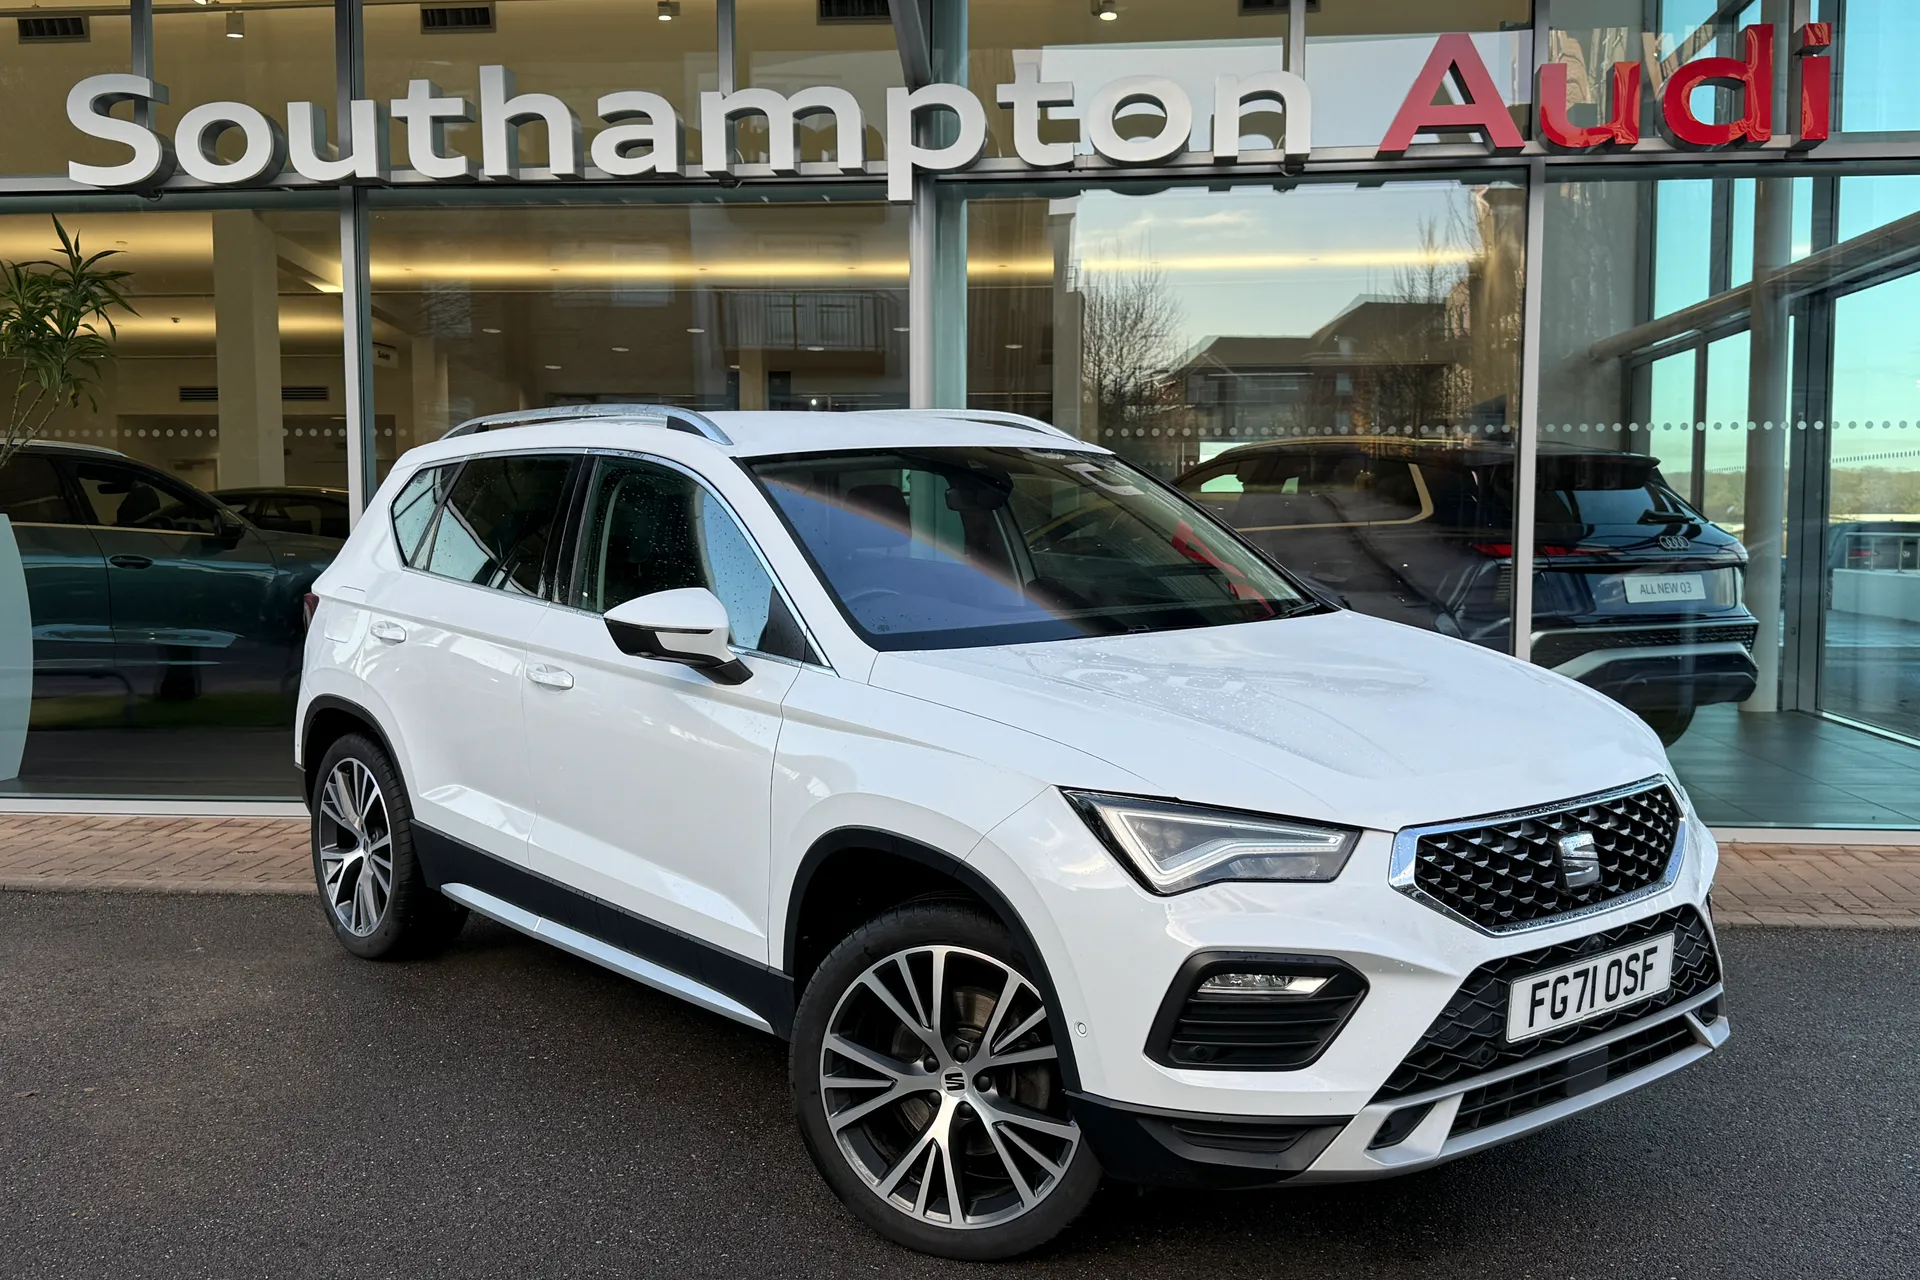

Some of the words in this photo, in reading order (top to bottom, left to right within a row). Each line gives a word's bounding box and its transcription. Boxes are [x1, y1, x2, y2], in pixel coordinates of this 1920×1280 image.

[66, 65, 1312, 202] Southampton
[1378, 22, 1831, 153] Audi
[1640, 583, 1656, 594] ALL
[1657, 582, 1678, 594] NEW
[1680, 581, 1692, 594] Q3
[1528, 965, 1598, 1028] FG71
[1604, 946, 1658, 1003] OSF
